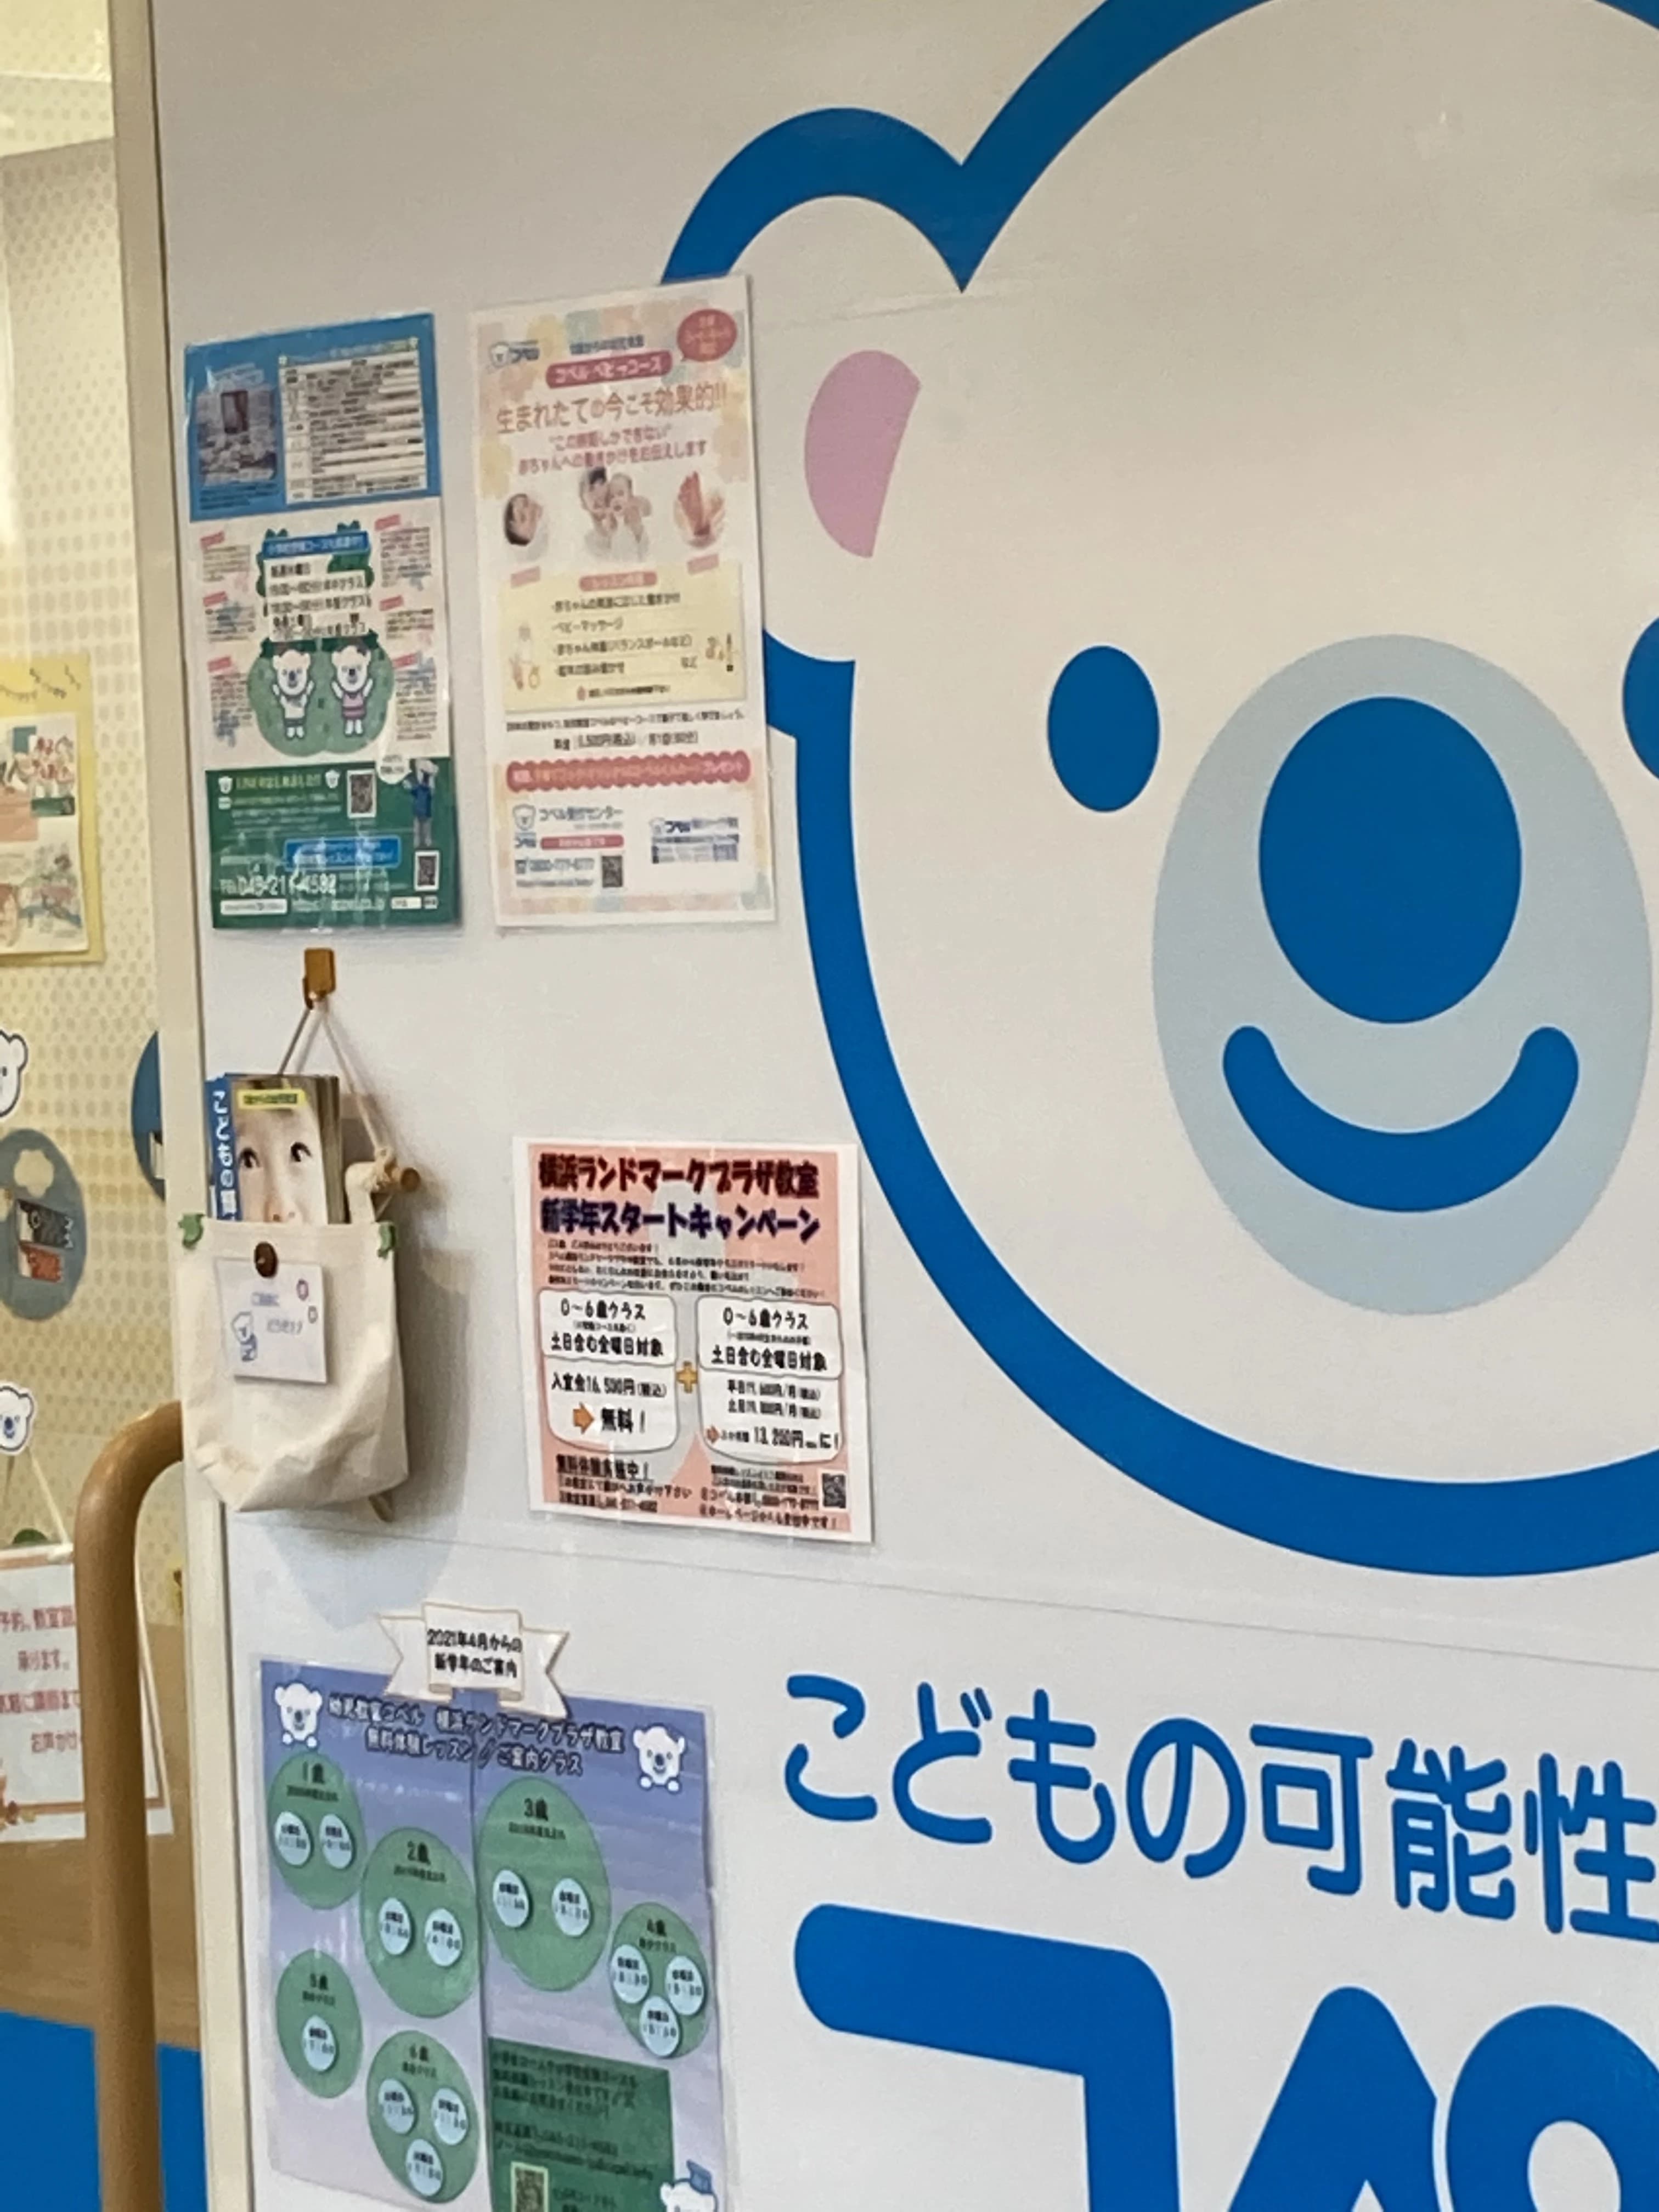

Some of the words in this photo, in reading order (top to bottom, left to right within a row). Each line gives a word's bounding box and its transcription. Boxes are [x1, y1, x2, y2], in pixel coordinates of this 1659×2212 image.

[539, 1153, 820, 1199] 横浜ランドマークプラザ教室
[540, 1198, 820, 1243] 新学年スタートキャンペーン
[427, 1627, 523, 1654] 2021年4月からの
[434, 1654, 517, 1679] 新学年のご案内
[785, 1674, 1659, 1943] こどもの可能性
